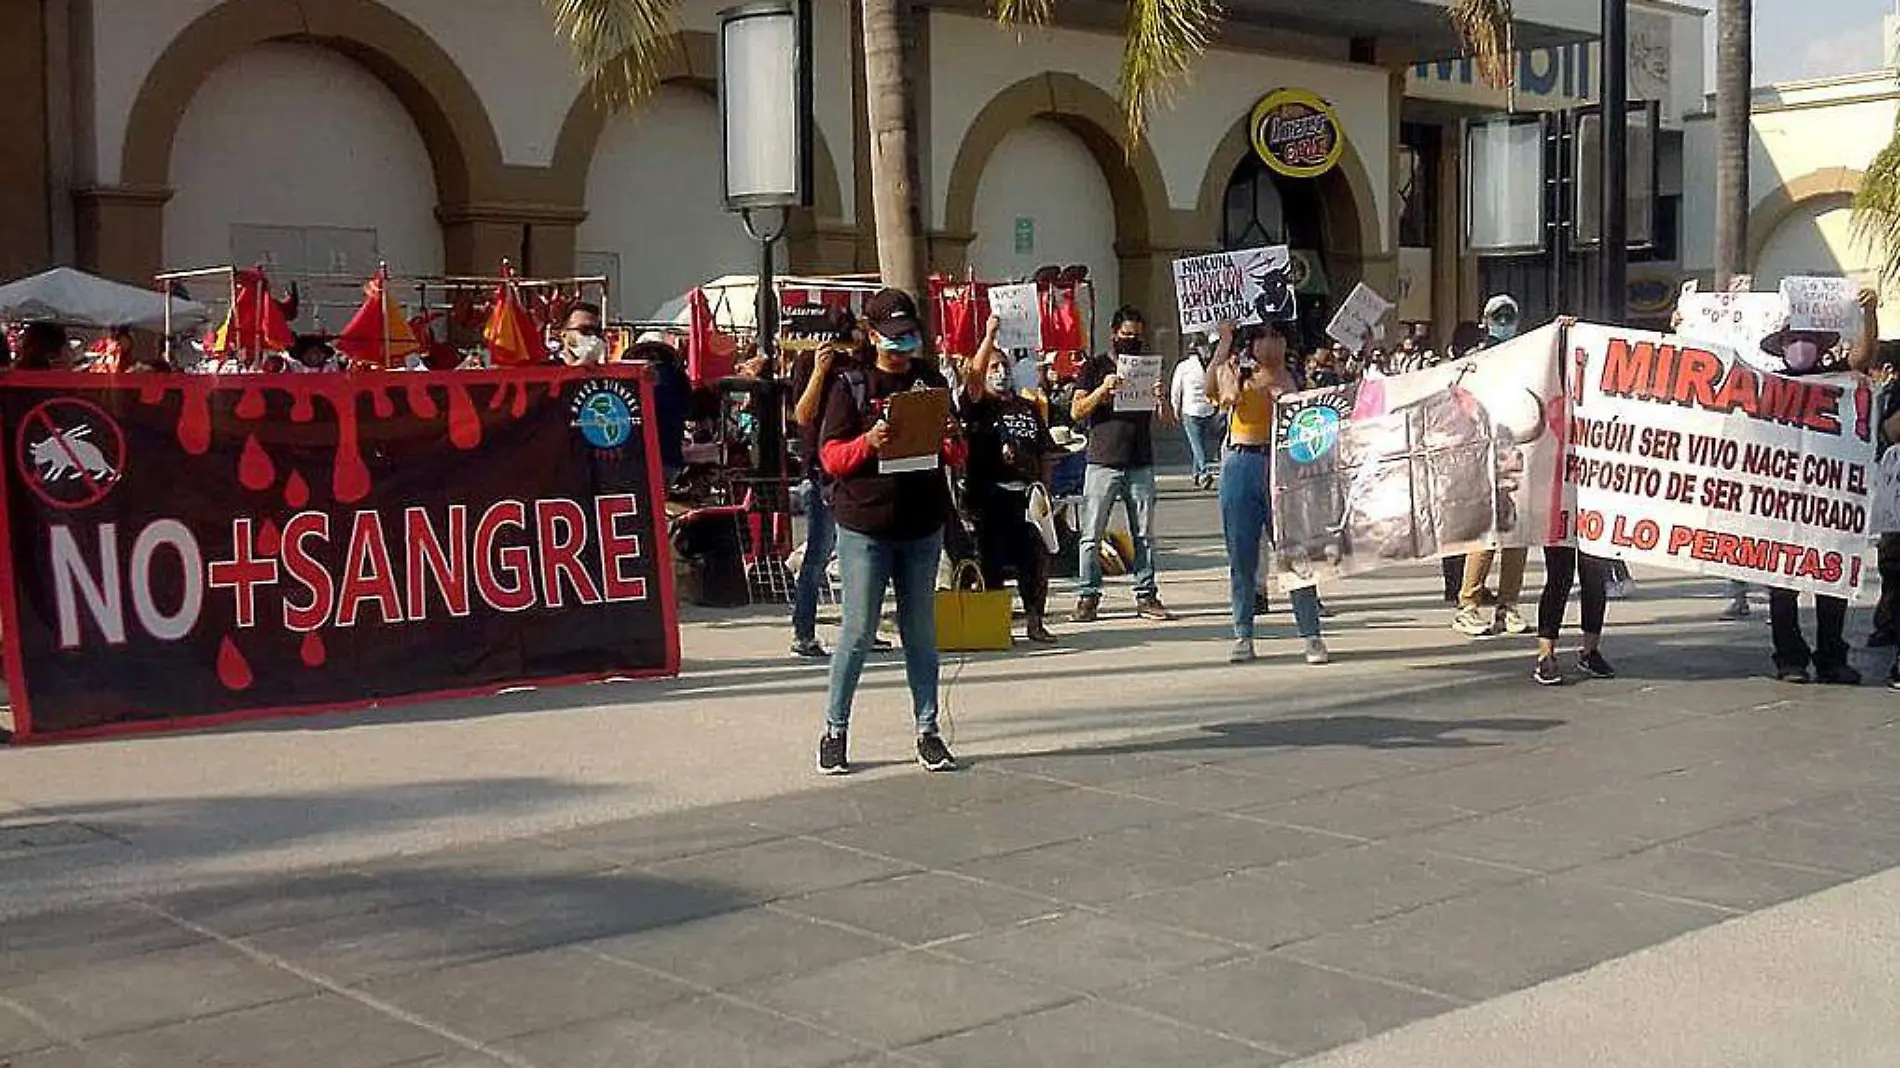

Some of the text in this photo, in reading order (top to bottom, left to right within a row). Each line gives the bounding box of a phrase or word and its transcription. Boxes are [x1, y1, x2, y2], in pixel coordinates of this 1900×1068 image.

[1600, 337, 1843, 436] MIRAME
[1639, 427, 1681, 461] SER
[1688, 434, 1738, 470] VIVO
[1742, 443, 1798, 481] NACE
[1803, 454, 1844, 490] CON
[1848, 463, 1867, 496] EL
[1665, 471, 1696, 502] DE
[1701, 477, 1743, 512] SER
[1750, 484, 1865, 533] TORTURADO
[1611, 514, 1660, 550] LO
[1667, 525, 1843, 583] PERMITAS
